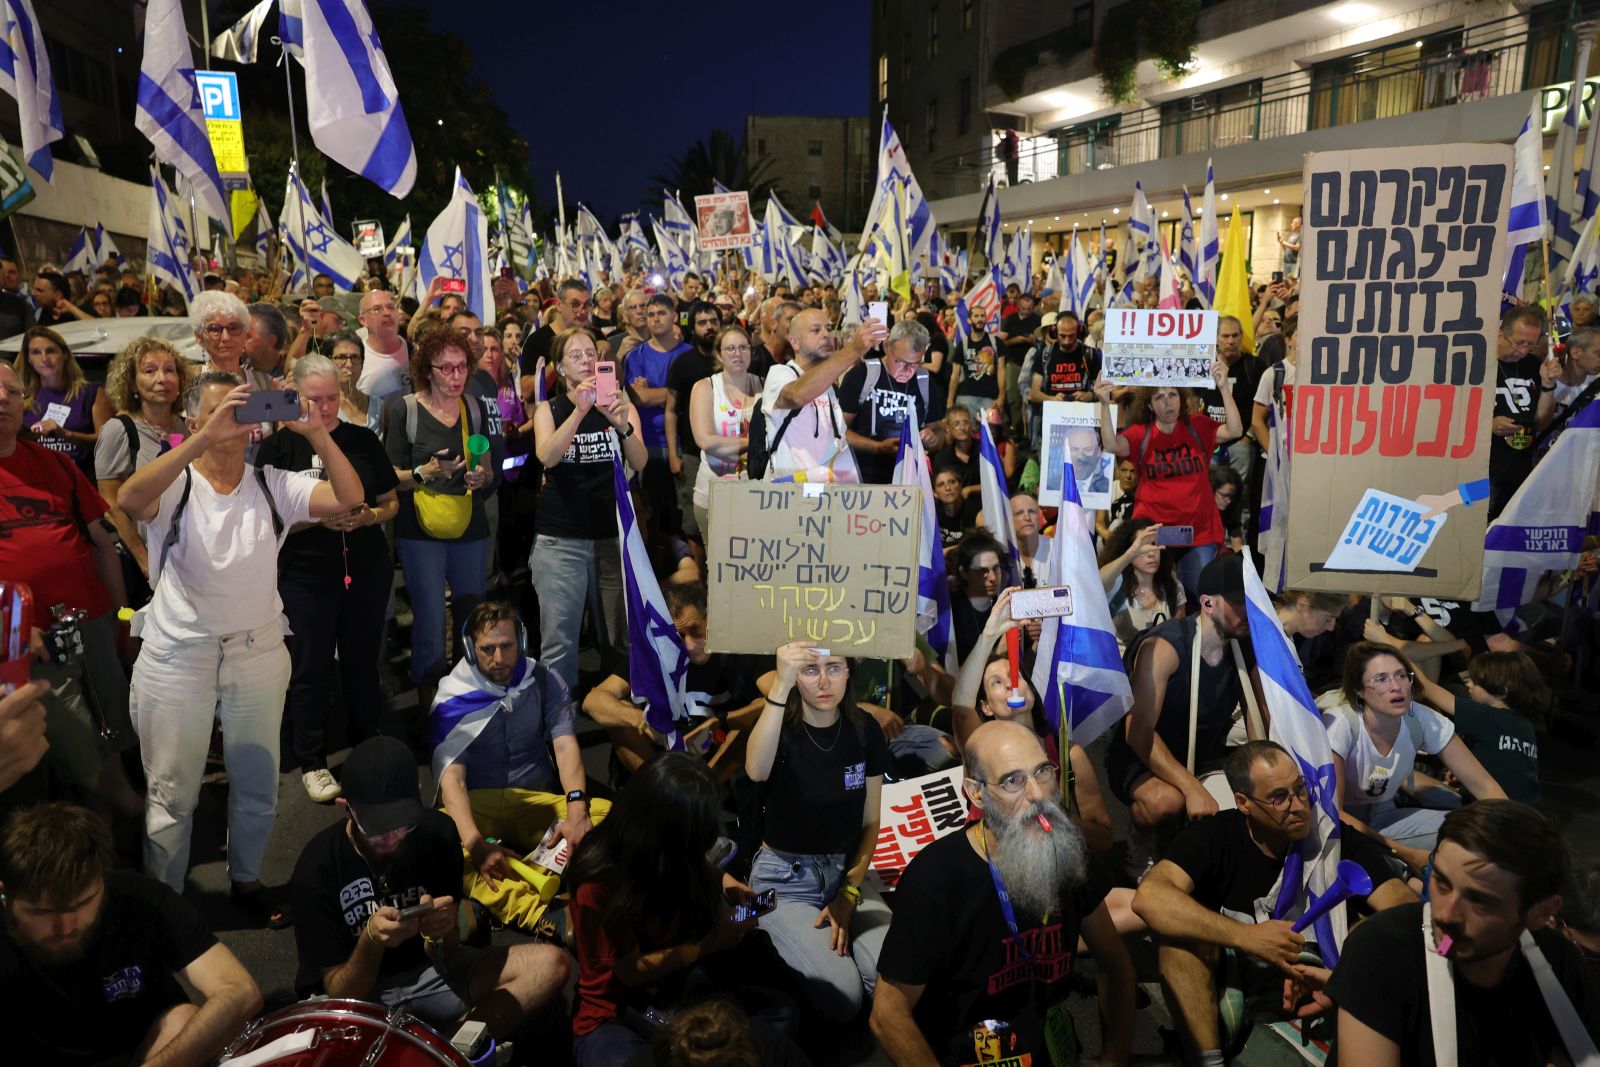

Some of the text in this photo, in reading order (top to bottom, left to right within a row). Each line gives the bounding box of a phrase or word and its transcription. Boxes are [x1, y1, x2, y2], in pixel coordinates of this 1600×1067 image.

[1310, 164, 1507, 228] הפקרתם
[1316, 224, 1497, 281] פילגתם
[1325, 280, 1484, 335] בזזתם
[1147, 312, 1204, 340] עופו
[1310, 332, 1487, 386] הרסתם
[1294, 384, 1483, 459] נכשלתם
[749, 488, 912, 512] לא עשיתי יותר
[798, 515, 832, 538] ימי
[1524, 528, 1568, 540] חופשי
[729, 536, 826, 564] מילואים
[1524, 539, 1569, 551] בארצנו
[796, 563, 850, 584] שהם
[863, 564, 911, 588] כדי
[752, 584, 847, 624] עסקה
[787, 615, 876, 645] עכשיו
[341, 880, 373, 905] 272
